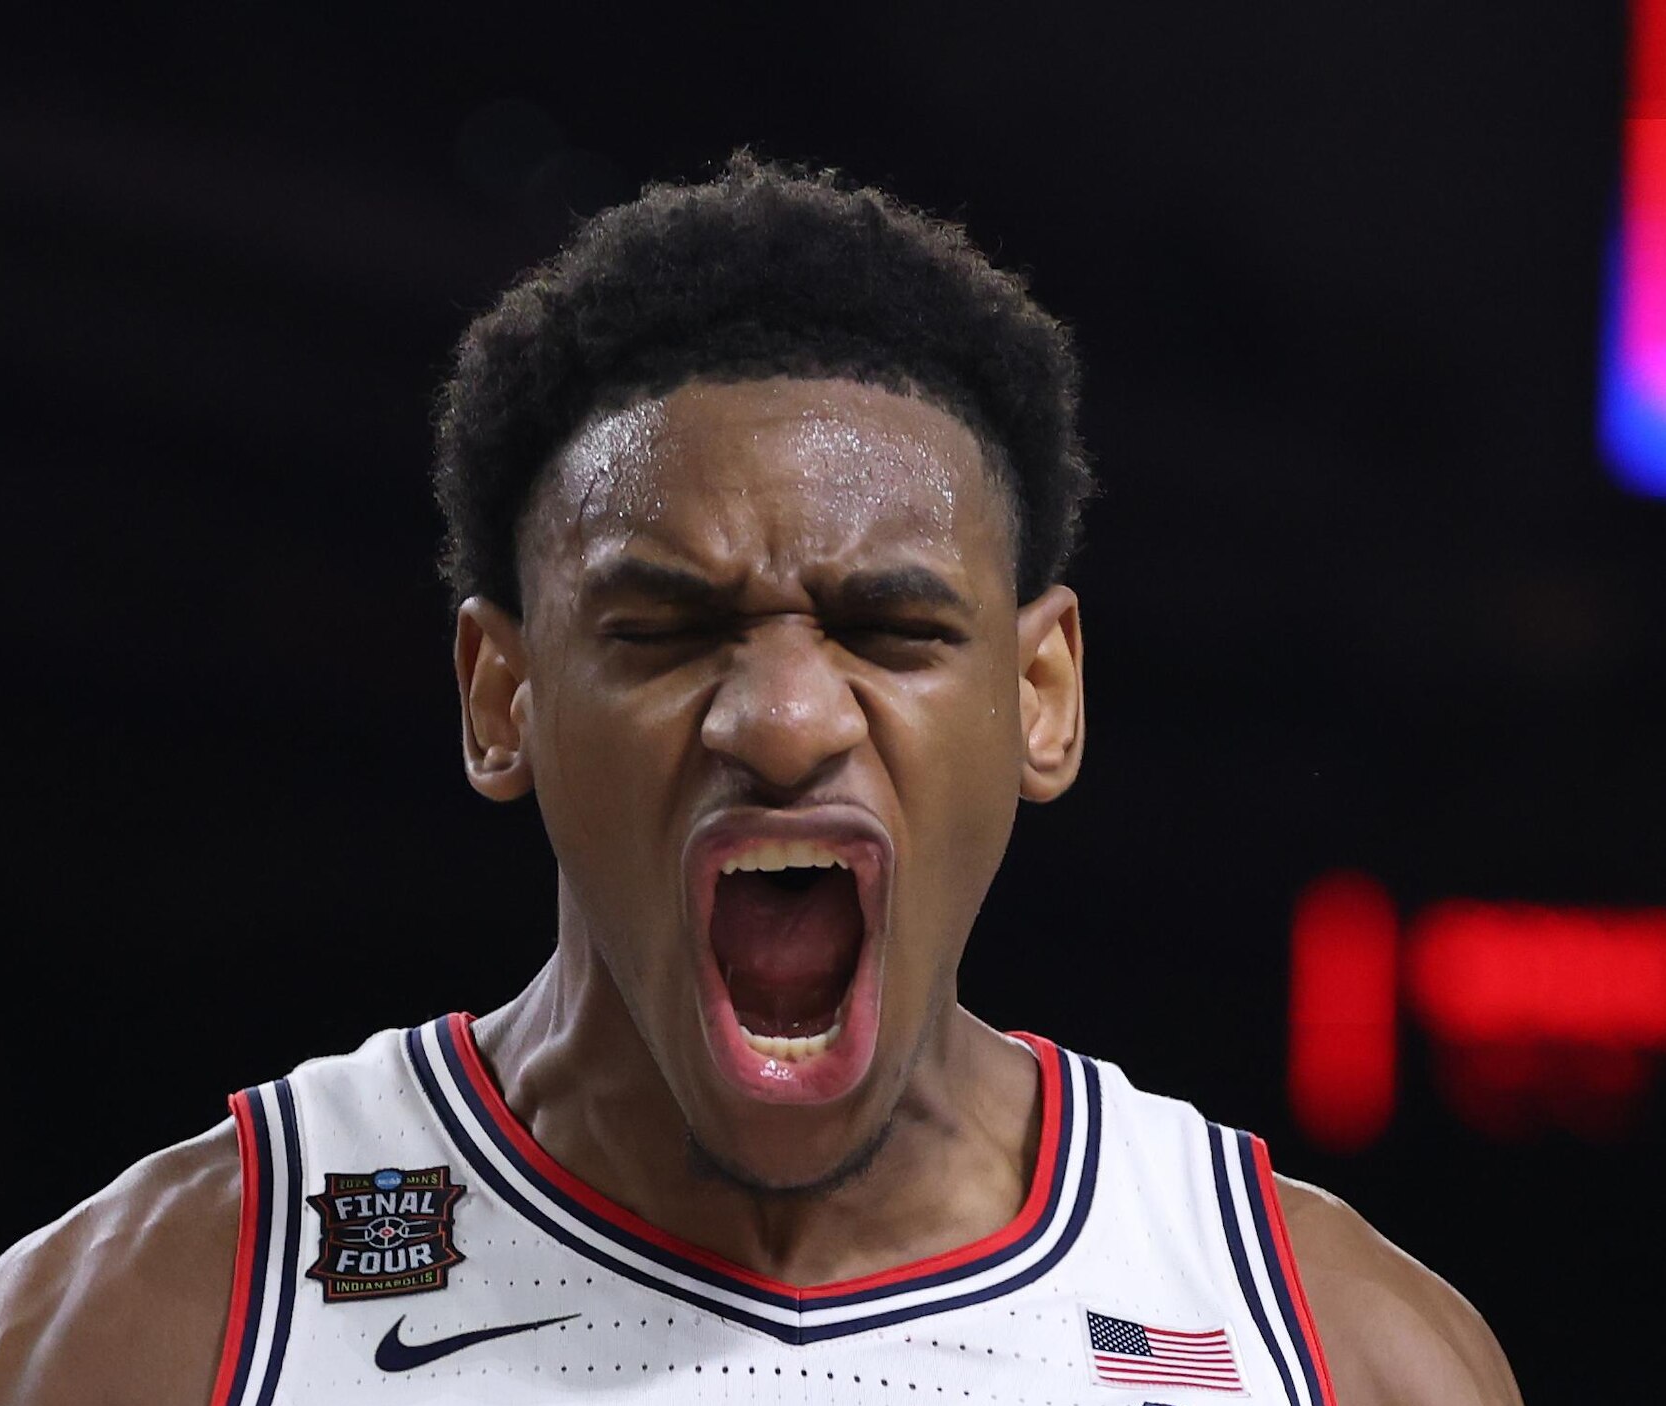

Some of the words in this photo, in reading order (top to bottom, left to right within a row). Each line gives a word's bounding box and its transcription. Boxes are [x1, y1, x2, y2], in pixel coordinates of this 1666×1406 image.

[334, 1190, 435, 1220] FINAL
[336, 1243, 434, 1275] FOUR
[336, 1271, 434, 1292] INDIANAPOLIS
